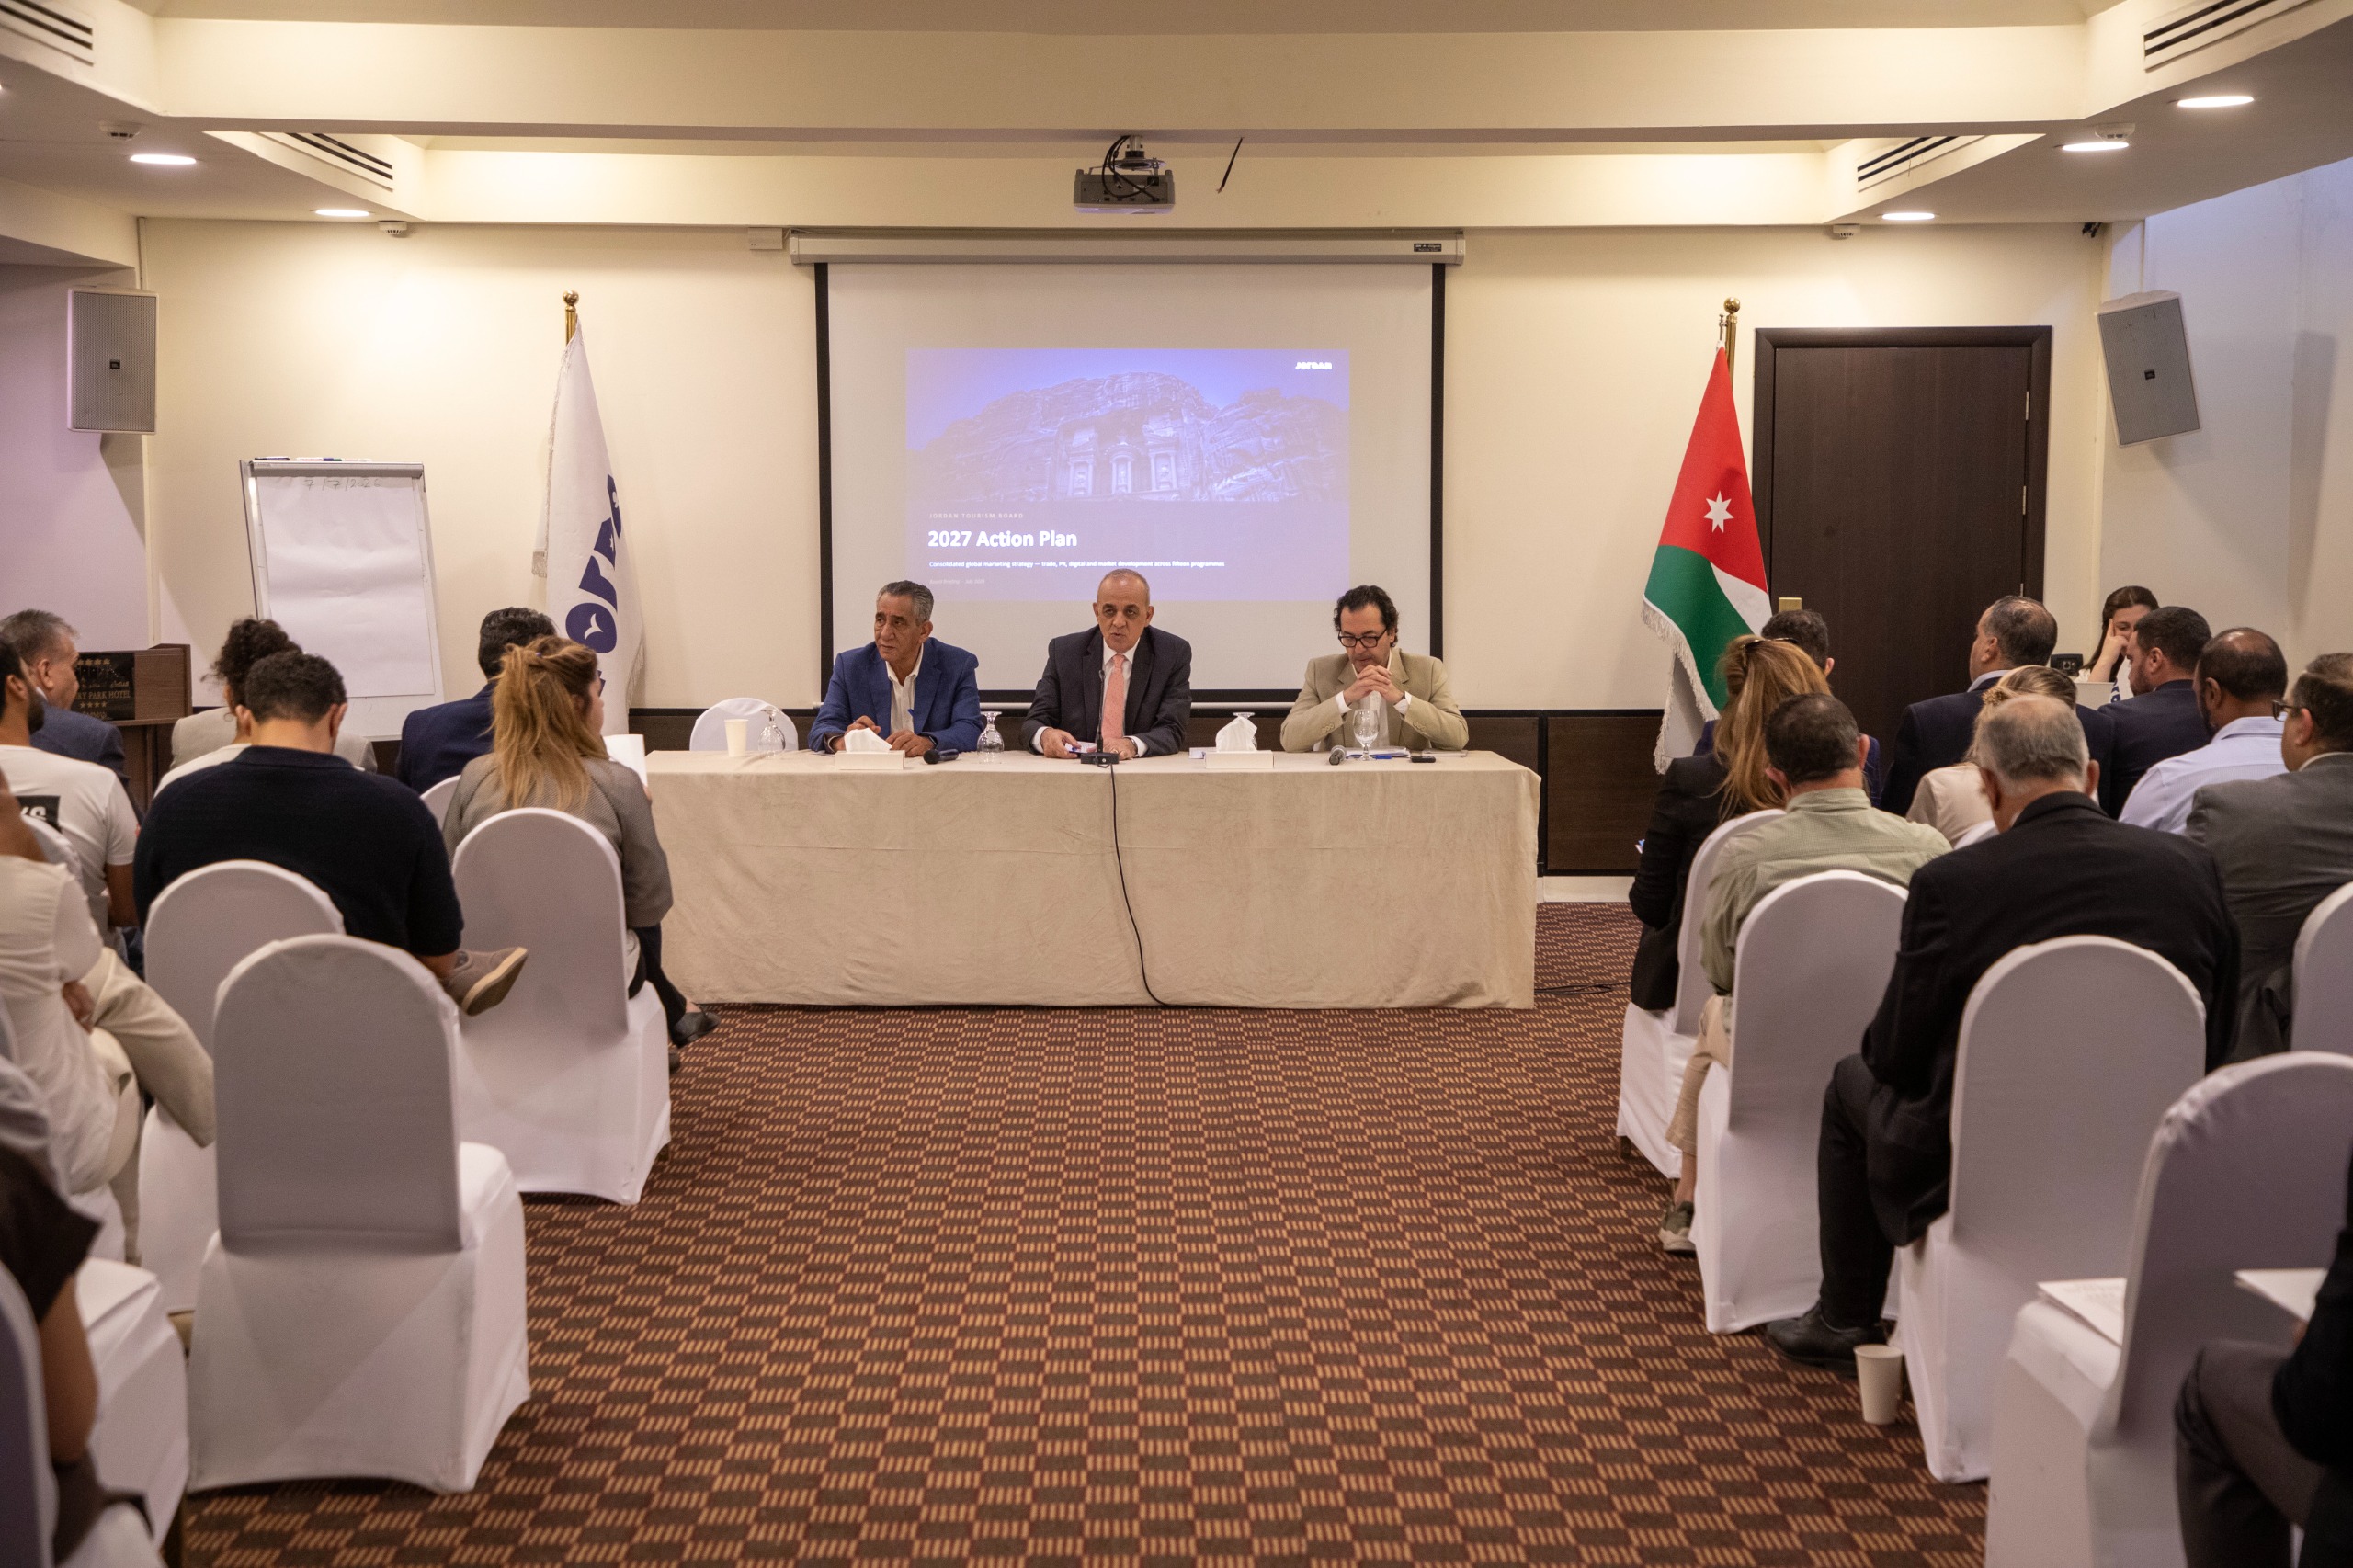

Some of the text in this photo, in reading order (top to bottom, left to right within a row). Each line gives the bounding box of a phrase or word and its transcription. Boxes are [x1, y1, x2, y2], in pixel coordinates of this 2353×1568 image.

[927, 530, 1078, 547] 2027 Action Plan
[965, 561, 983, 569] global
[983, 561, 1011, 569] marketing
[1011, 561, 1034, 569] strategy
[1068, 561, 1086, 569] digital
[88, 691, 108, 699] PARK
[108, 690, 131, 699] HOTEL
